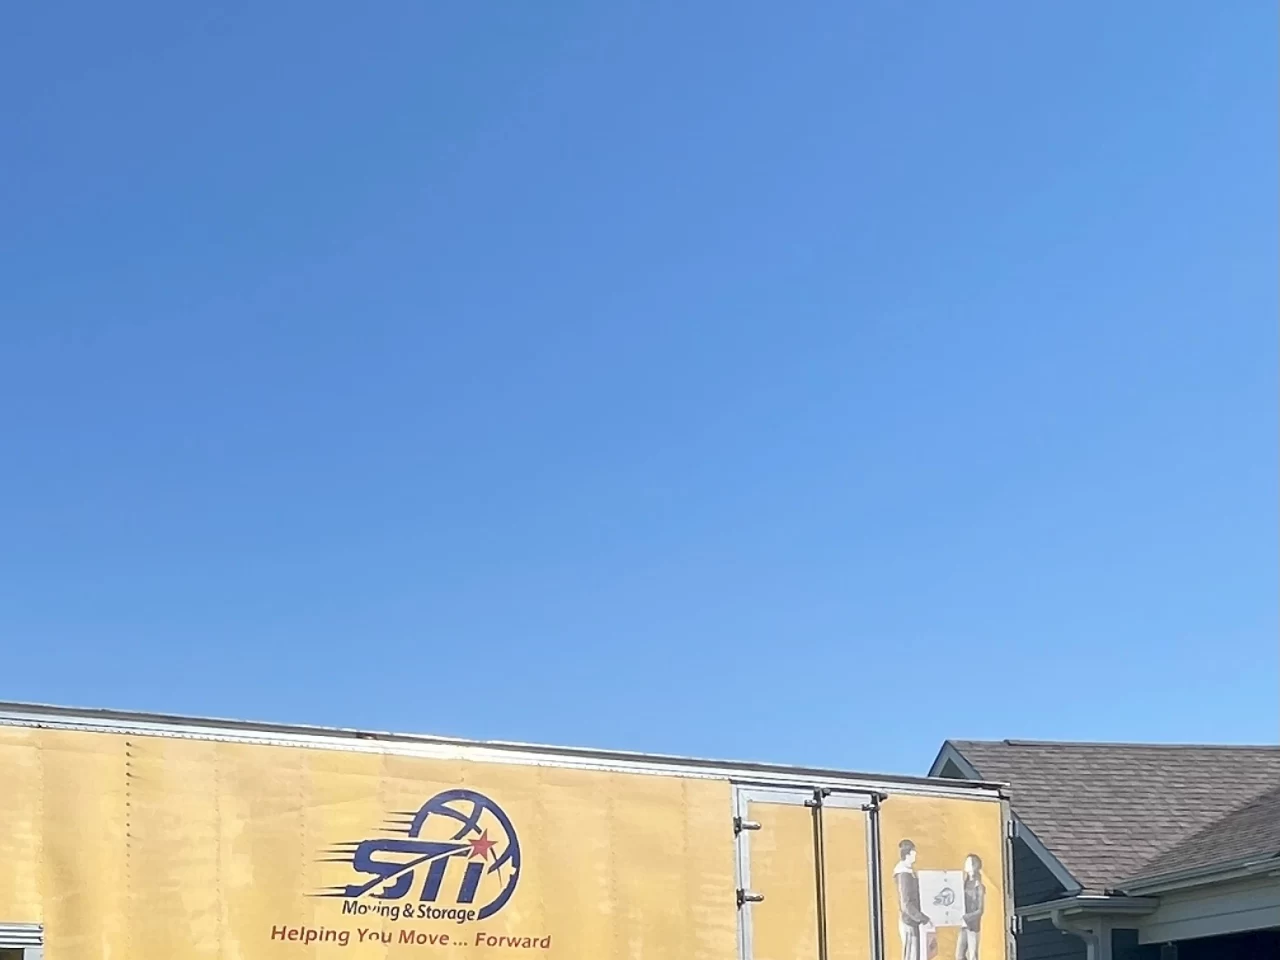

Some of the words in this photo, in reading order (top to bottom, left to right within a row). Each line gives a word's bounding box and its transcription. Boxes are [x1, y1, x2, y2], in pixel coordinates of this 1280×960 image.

[342, 900, 400, 921] Moving
[402, 903, 415, 918] &
[417, 904, 475, 924] Storage
[271, 925, 350, 946] Helping
[356, 928, 392, 944] You
[475, 932, 551, 949] Forward
